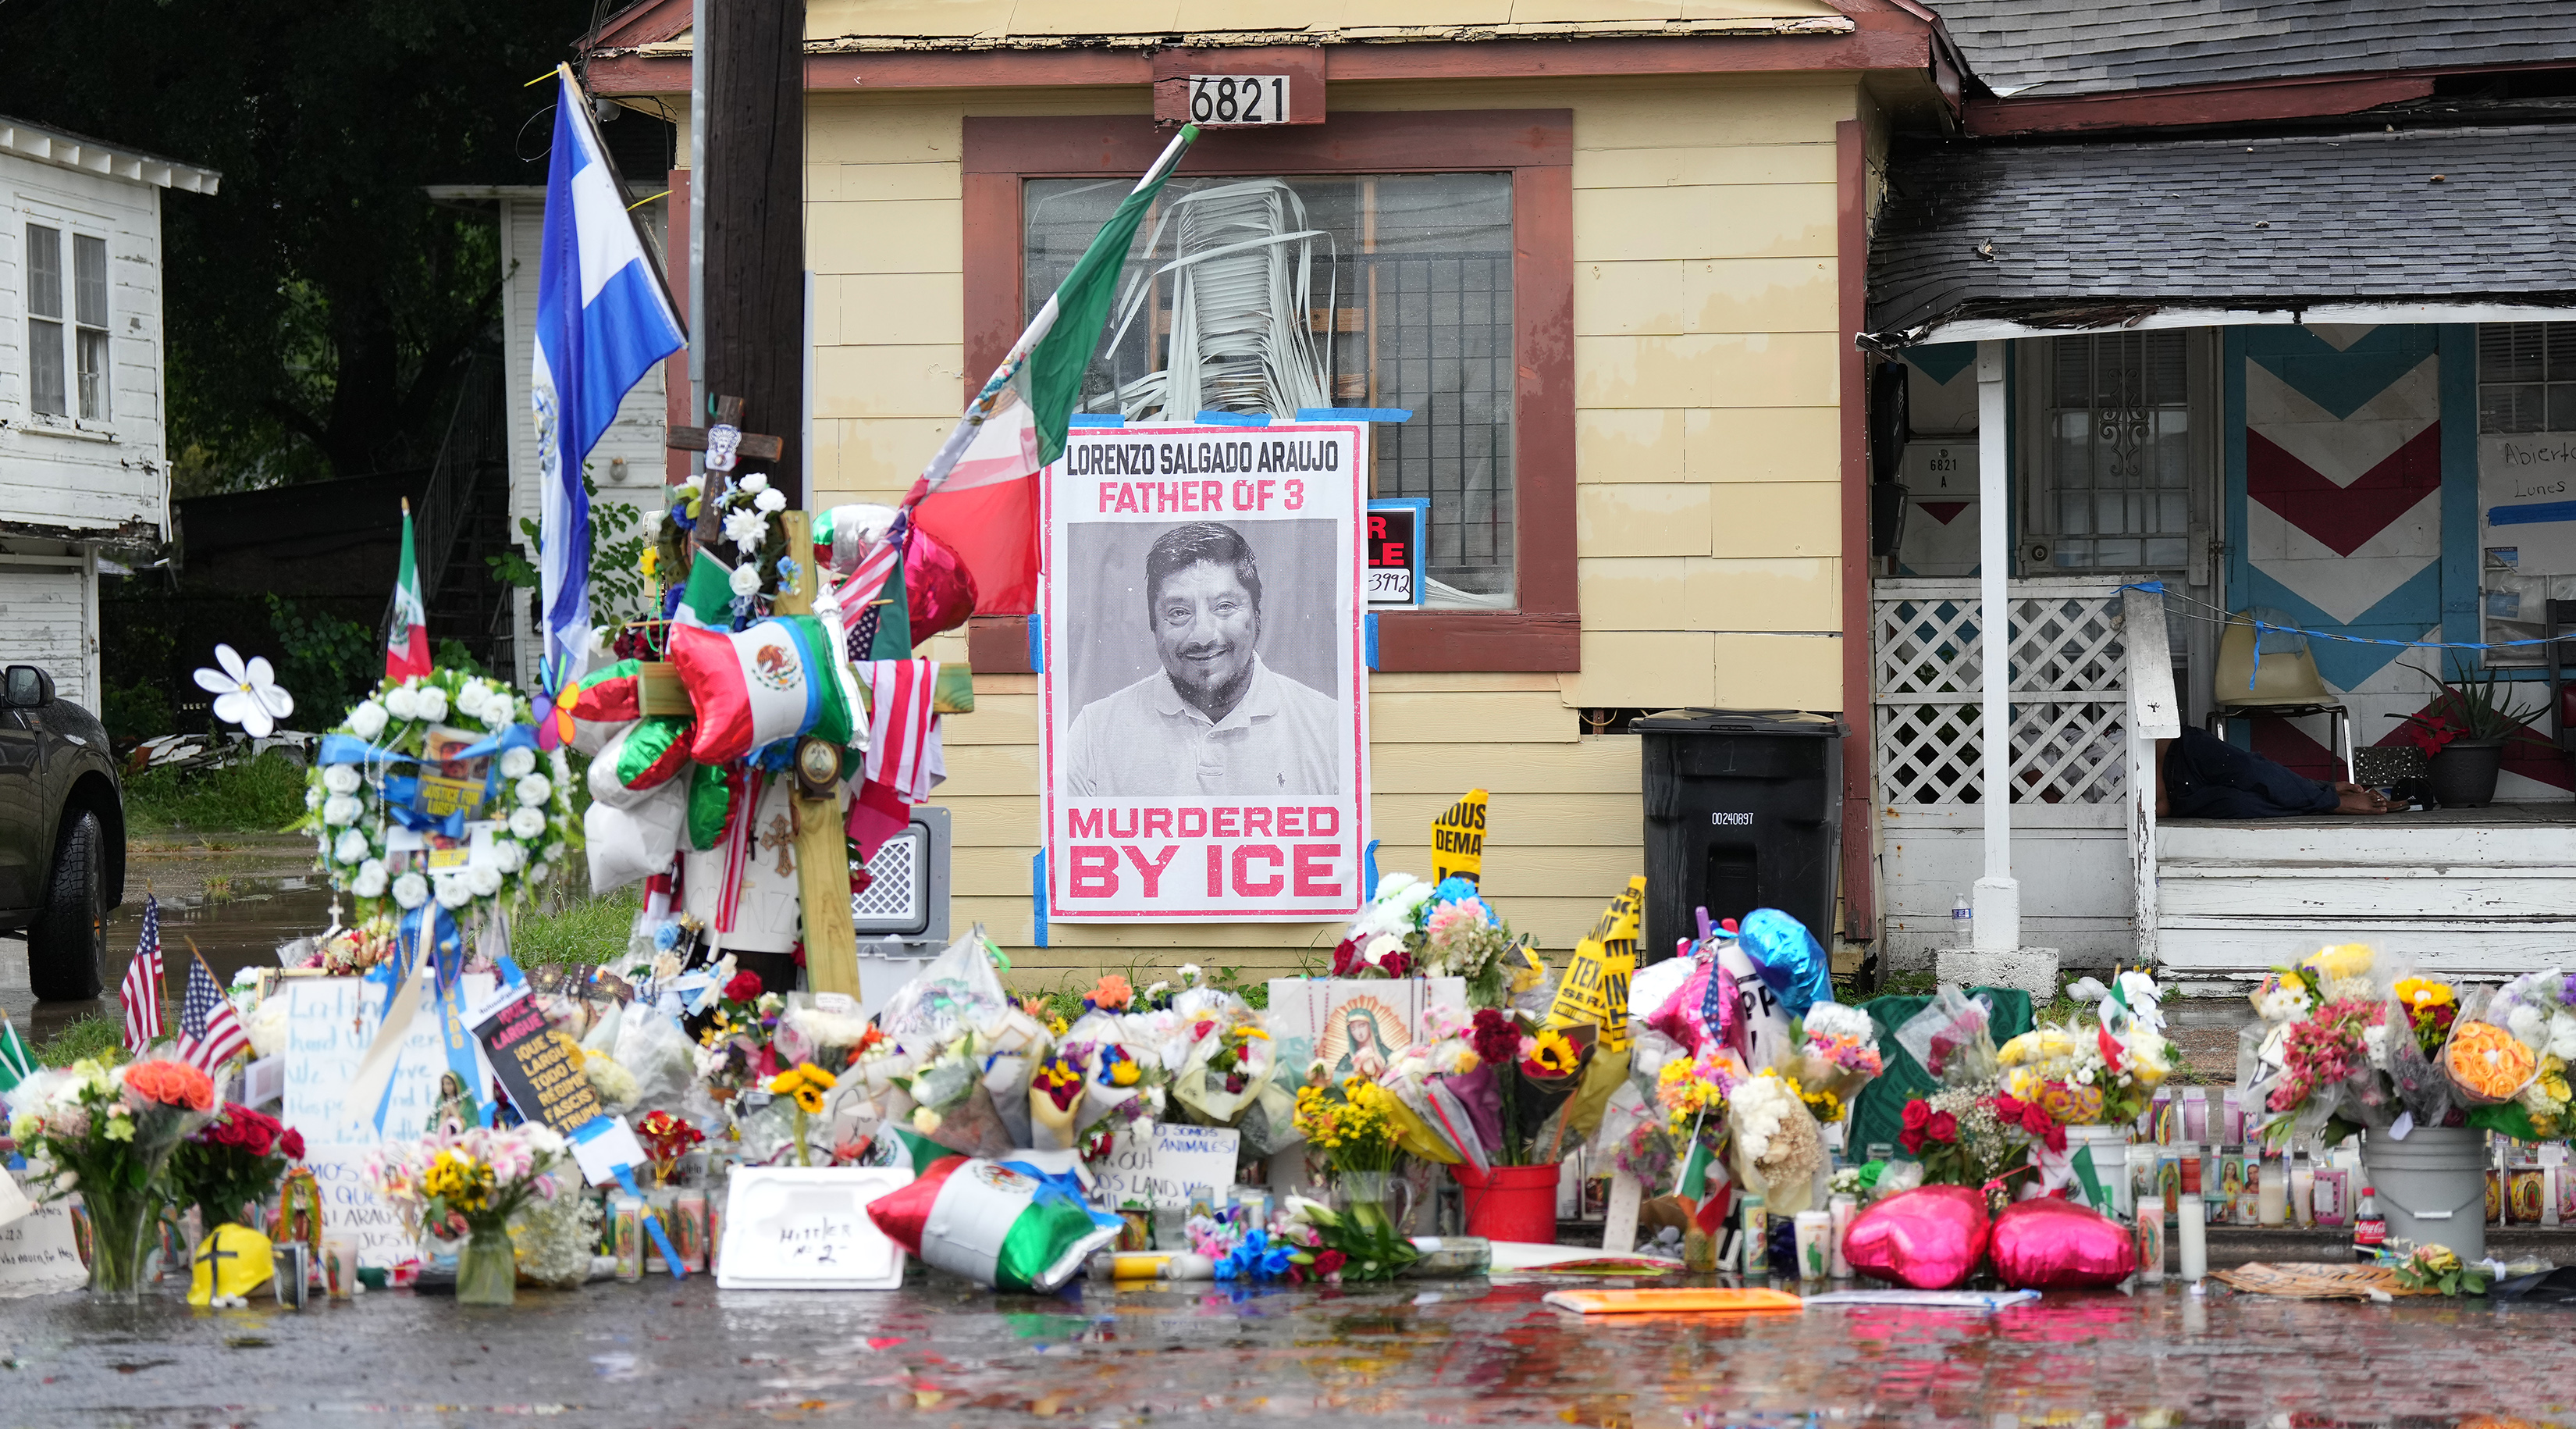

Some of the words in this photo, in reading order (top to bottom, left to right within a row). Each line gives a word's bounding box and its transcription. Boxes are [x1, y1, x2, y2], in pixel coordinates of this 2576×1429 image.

[1191, 77, 1283, 122] 6821
[1067, 443, 1155, 476] LORENZO
[1160, 441, 1251, 473] SALGADO
[1257, 440, 1338, 472] ARAUJO
[1930, 459, 1956, 471] 6821
[1099, 480, 1223, 513] FATHER
[1233, 479, 1276, 511] OF
[1285, 479, 1304, 511] 3
[1941, 476, 1947, 488] A
[2514, 479, 2567, 498] Lunes
[1068, 806, 1340, 839] MURDERED
[1711, 812, 1754, 825] 00240897
[1436, 829, 1482, 856] DEMA
[1069, 844, 1179, 898] BY
[1207, 843, 1342, 897] ICE
[290, 985, 386, 1019] Latin
[521, 1044, 571, 1078] LARGU
[543, 1087, 596, 1124] FASCIS
[1173, 1125, 1219, 1138] SOMOS
[1132, 1174, 1179, 1199] LAND
